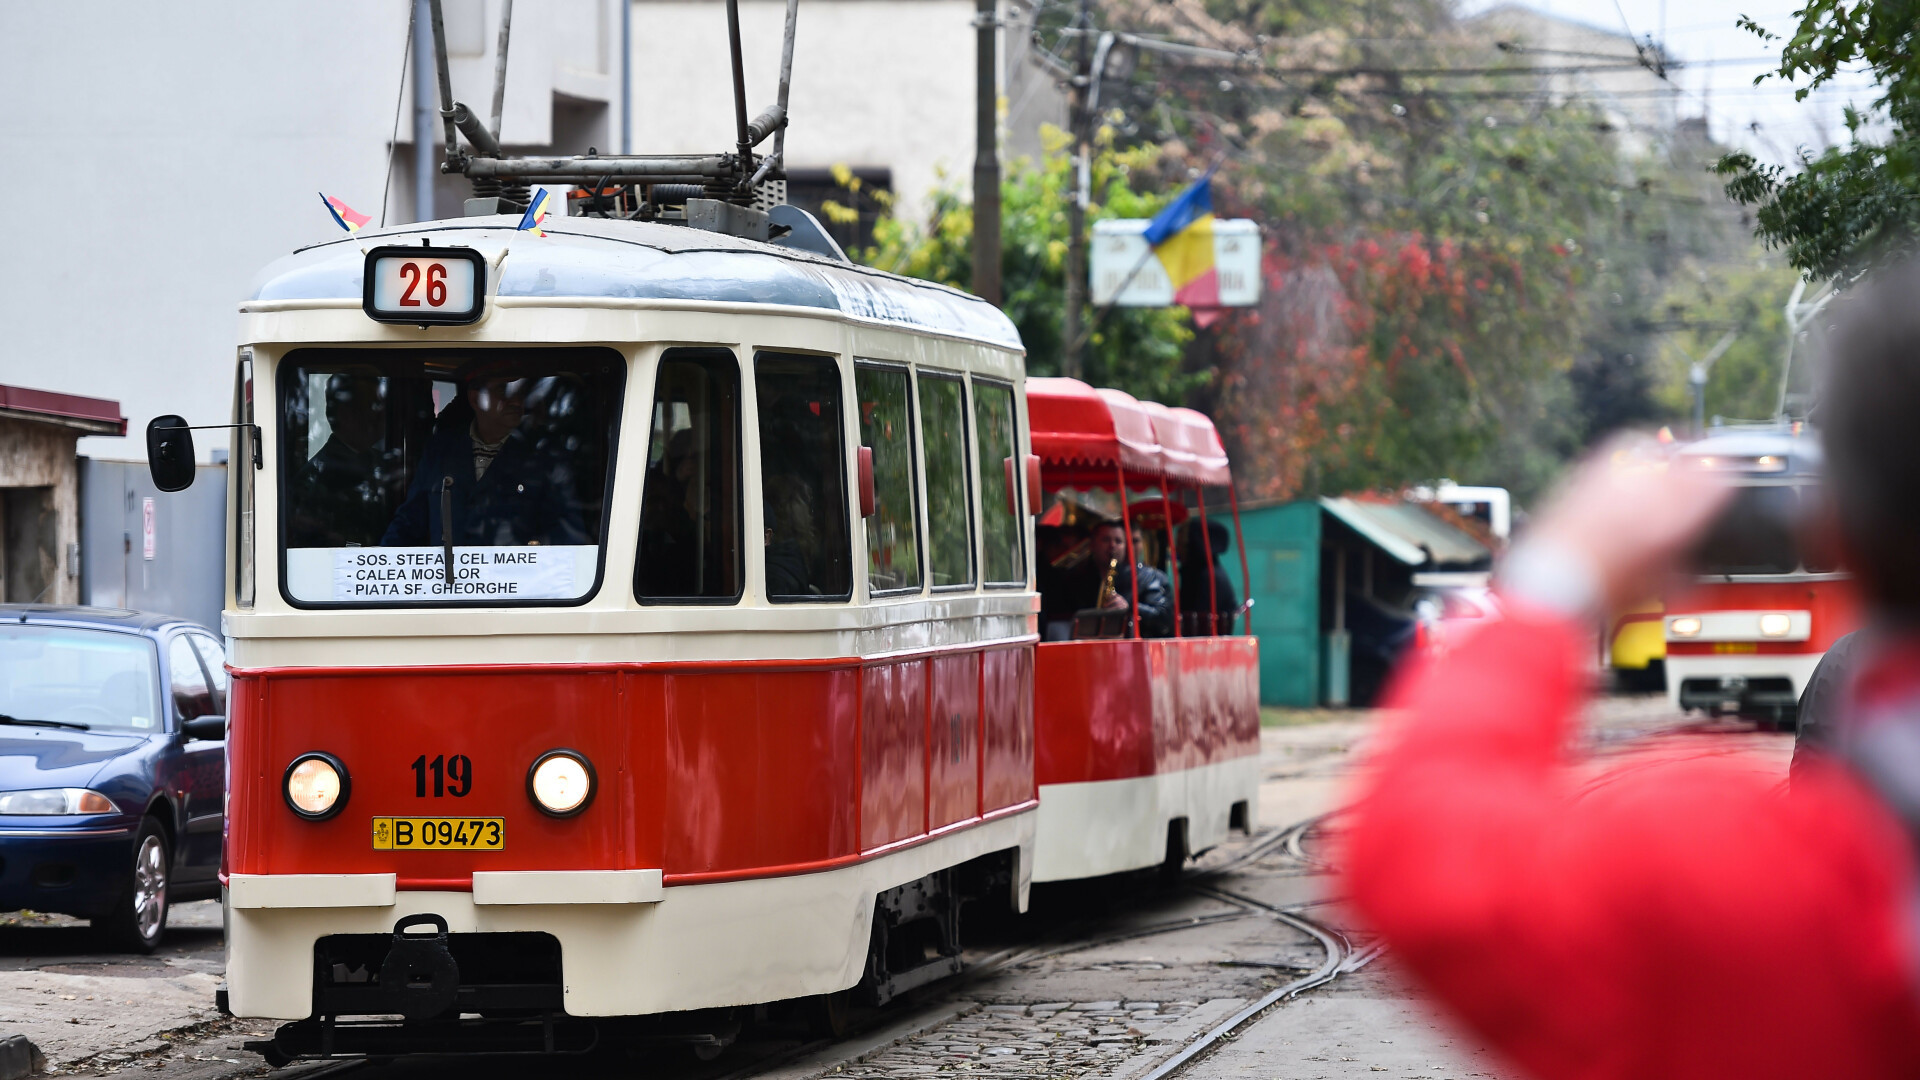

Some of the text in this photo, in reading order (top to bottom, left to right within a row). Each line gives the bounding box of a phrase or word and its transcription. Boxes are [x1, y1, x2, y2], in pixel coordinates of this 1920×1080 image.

[399, 262, 447, 307] 26
[356, 554, 391, 566] SOS.
[396, 553, 455, 565] STEFA
[460, 553, 489, 565] CEL
[494, 552, 537, 564] MARE
[356, 568, 407, 581] CALEA
[411, 568, 480, 580] MOSOR
[355, 583, 399, 595] PIATA
[404, 583, 427, 595] SF.
[431, 582, 518, 595] GHEORGHE
[411, 754, 472, 797] 119
[395, 821, 500, 846] B 09473
